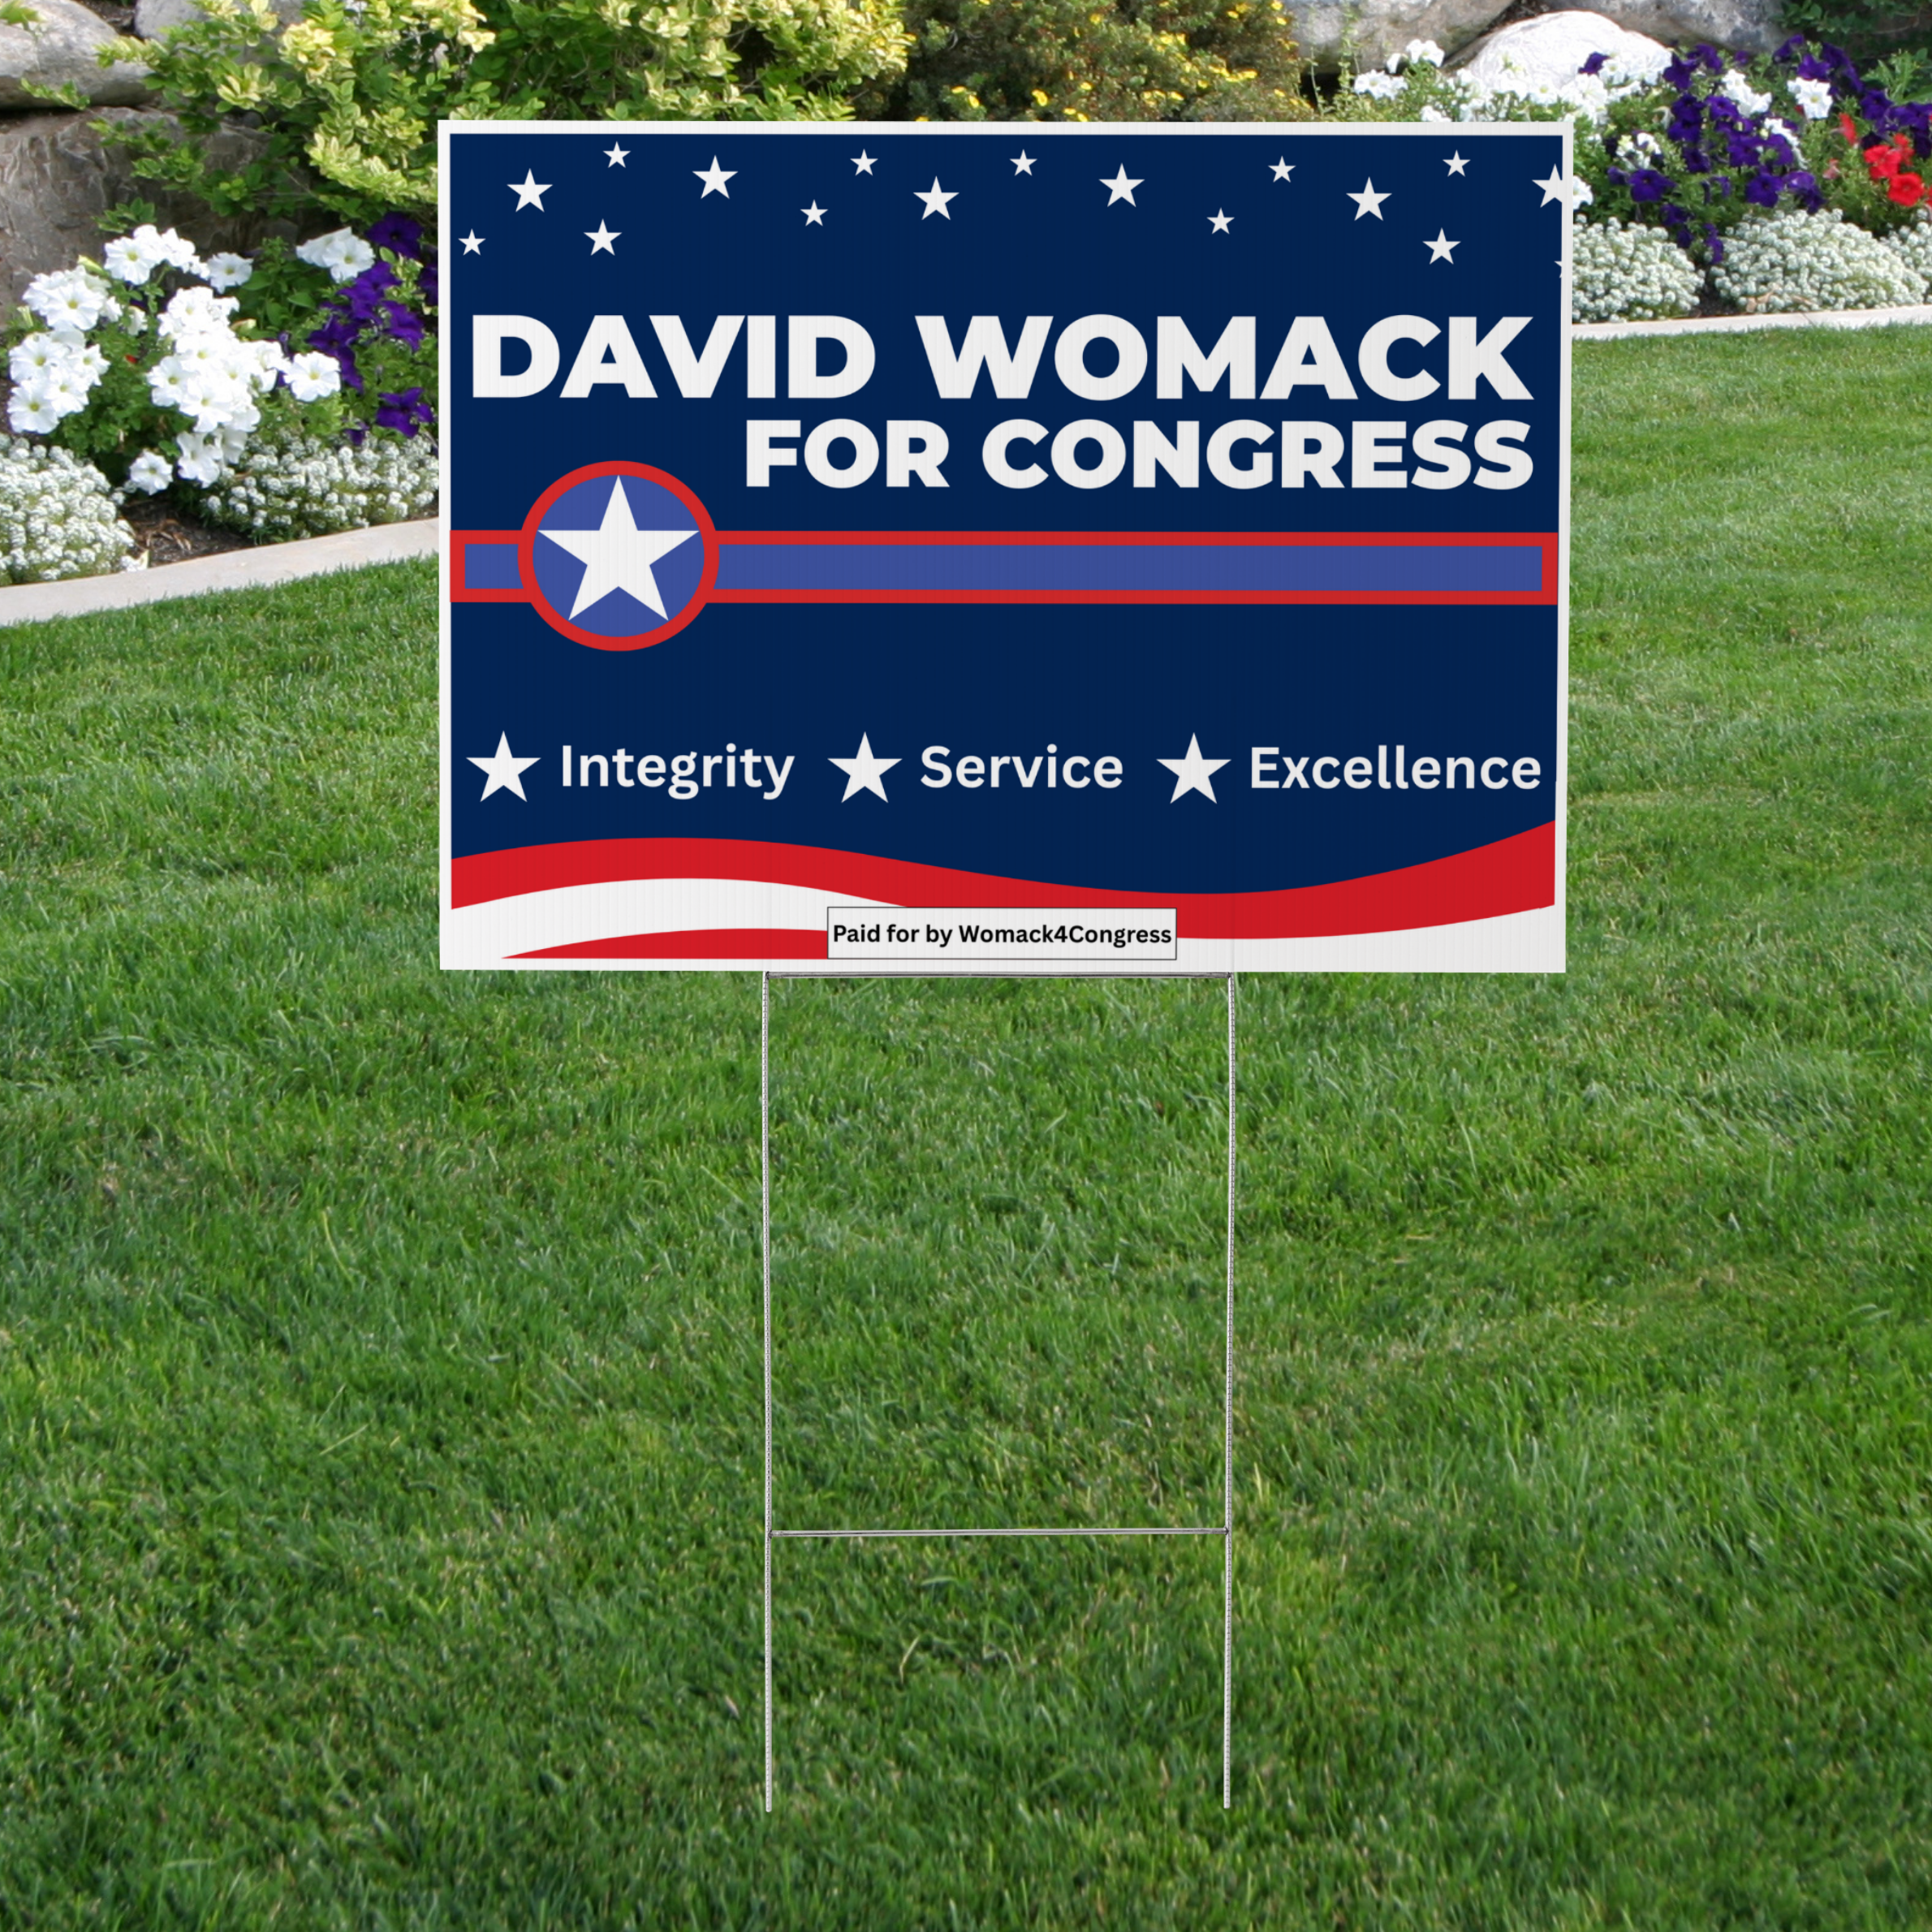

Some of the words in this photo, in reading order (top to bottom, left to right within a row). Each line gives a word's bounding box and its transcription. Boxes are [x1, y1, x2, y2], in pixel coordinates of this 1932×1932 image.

[473, 315, 875, 399] DAVID
[914, 313, 1534, 402] WOMACK
[746, 418, 950, 489] FOR
[981, 418, 1533, 490] CONGRESS
[563, 743, 796, 800] Integrity
[921, 744, 1123, 789] Service
[1251, 744, 1541, 790] Excellence
[833, 924, 881, 942] Paid
[886, 924, 920, 943] for
[926, 924, 953, 948] by
[958, 924, 1172, 949] Womack4Congress
